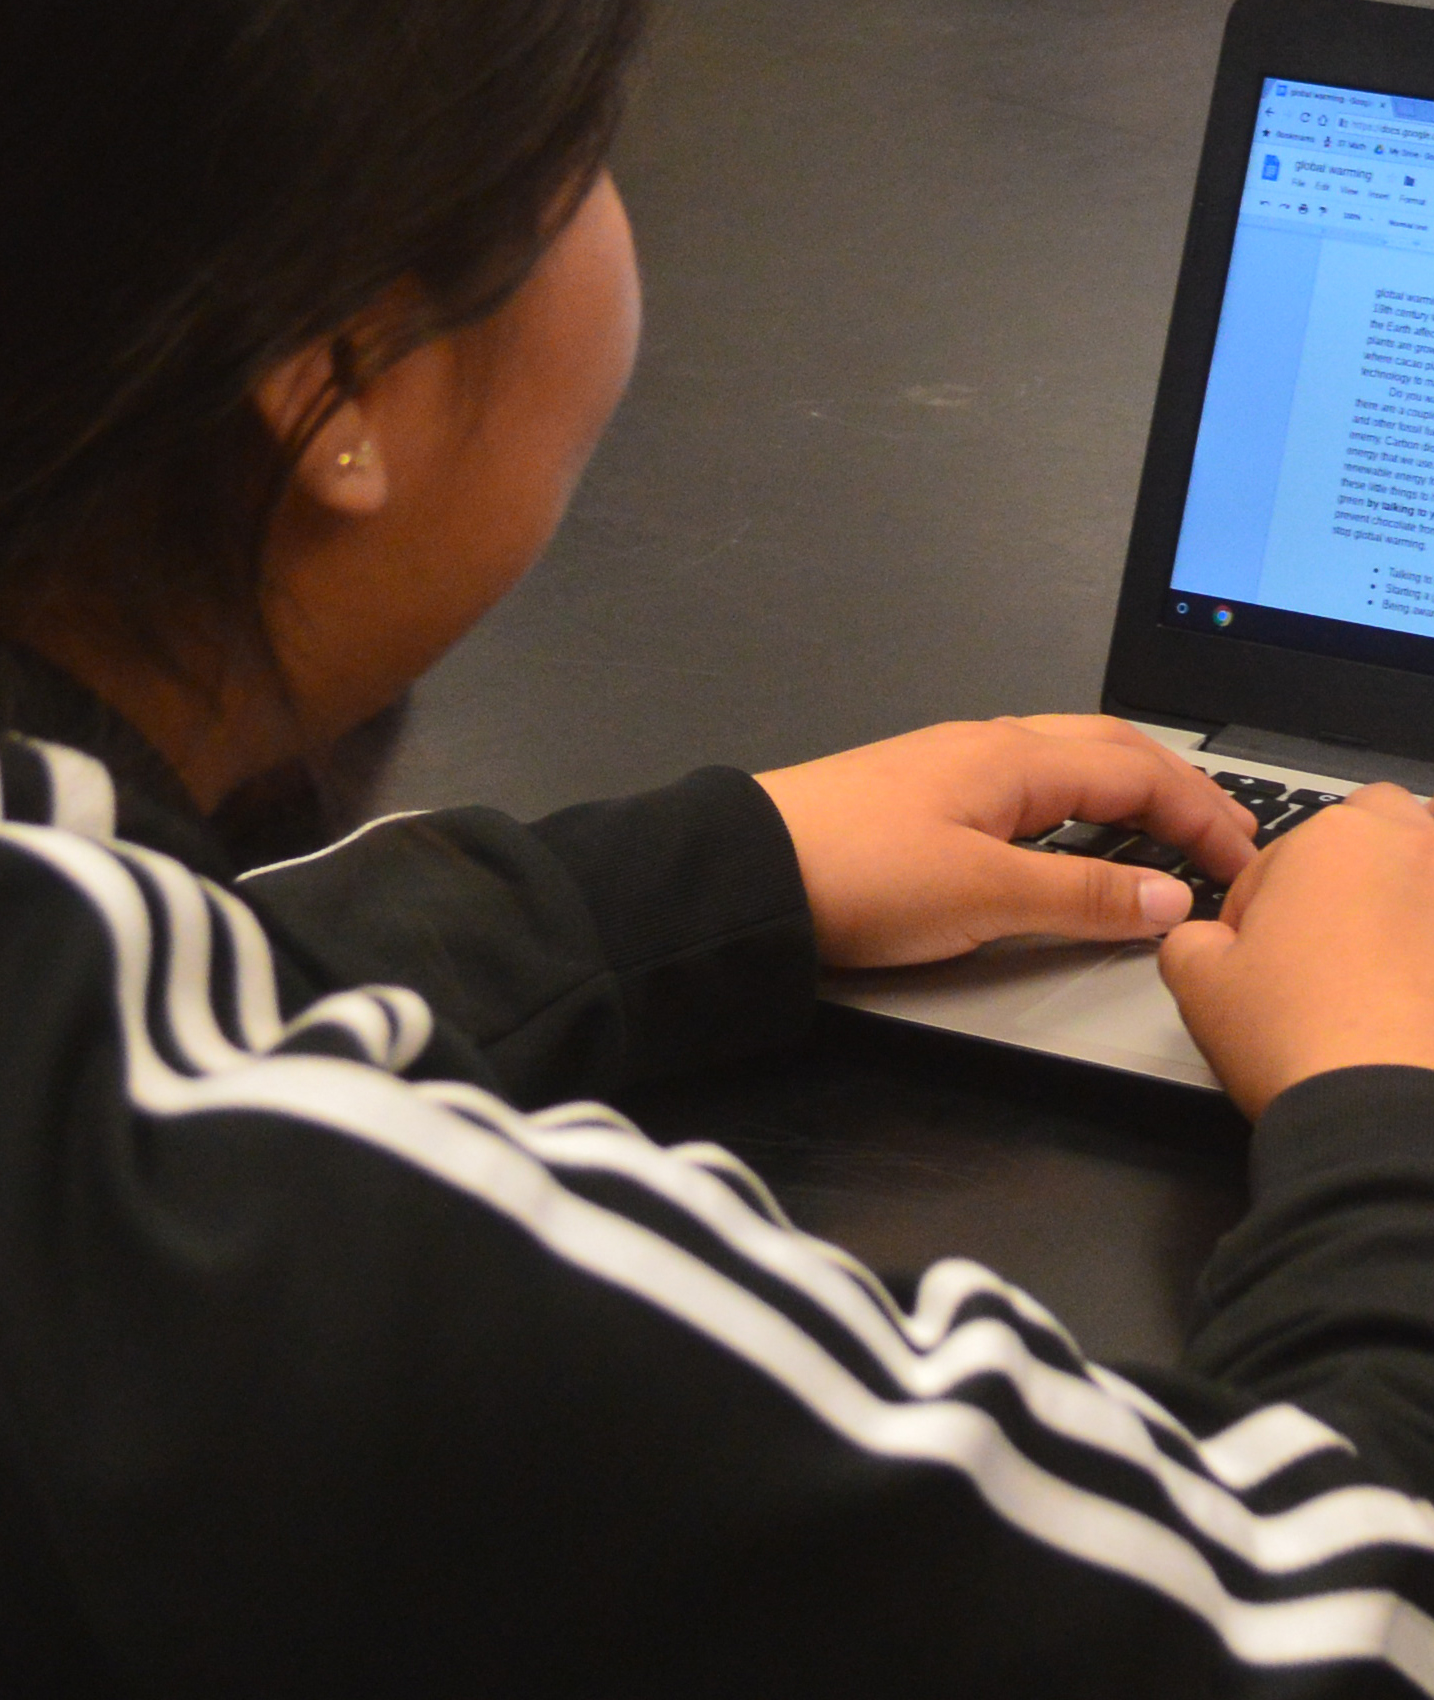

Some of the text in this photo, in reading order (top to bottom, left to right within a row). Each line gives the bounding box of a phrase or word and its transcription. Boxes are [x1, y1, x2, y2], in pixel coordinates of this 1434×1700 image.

[1293, 158, 1374, 183] global warming
[1373, 287, 1405, 301] global
[1393, 308, 1430, 324] century
[1367, 318, 1385, 331] the
[1385, 321, 1413, 335] Earth
[1364, 335, 1395, 349] plants
[1395, 341, 1413, 351] are
[1335, 494, 1365, 507] green
[1365, 497, 1380, 512] by
[1379, 500, 1415, 518] talking
[1415, 506, 1428, 518] to
[1386, 567, 1422, 585] Talking
[1422, 573, 1434, 585] to
[1383, 583, 1422, 602] Starting
[1381, 599, 1410, 616] Being
